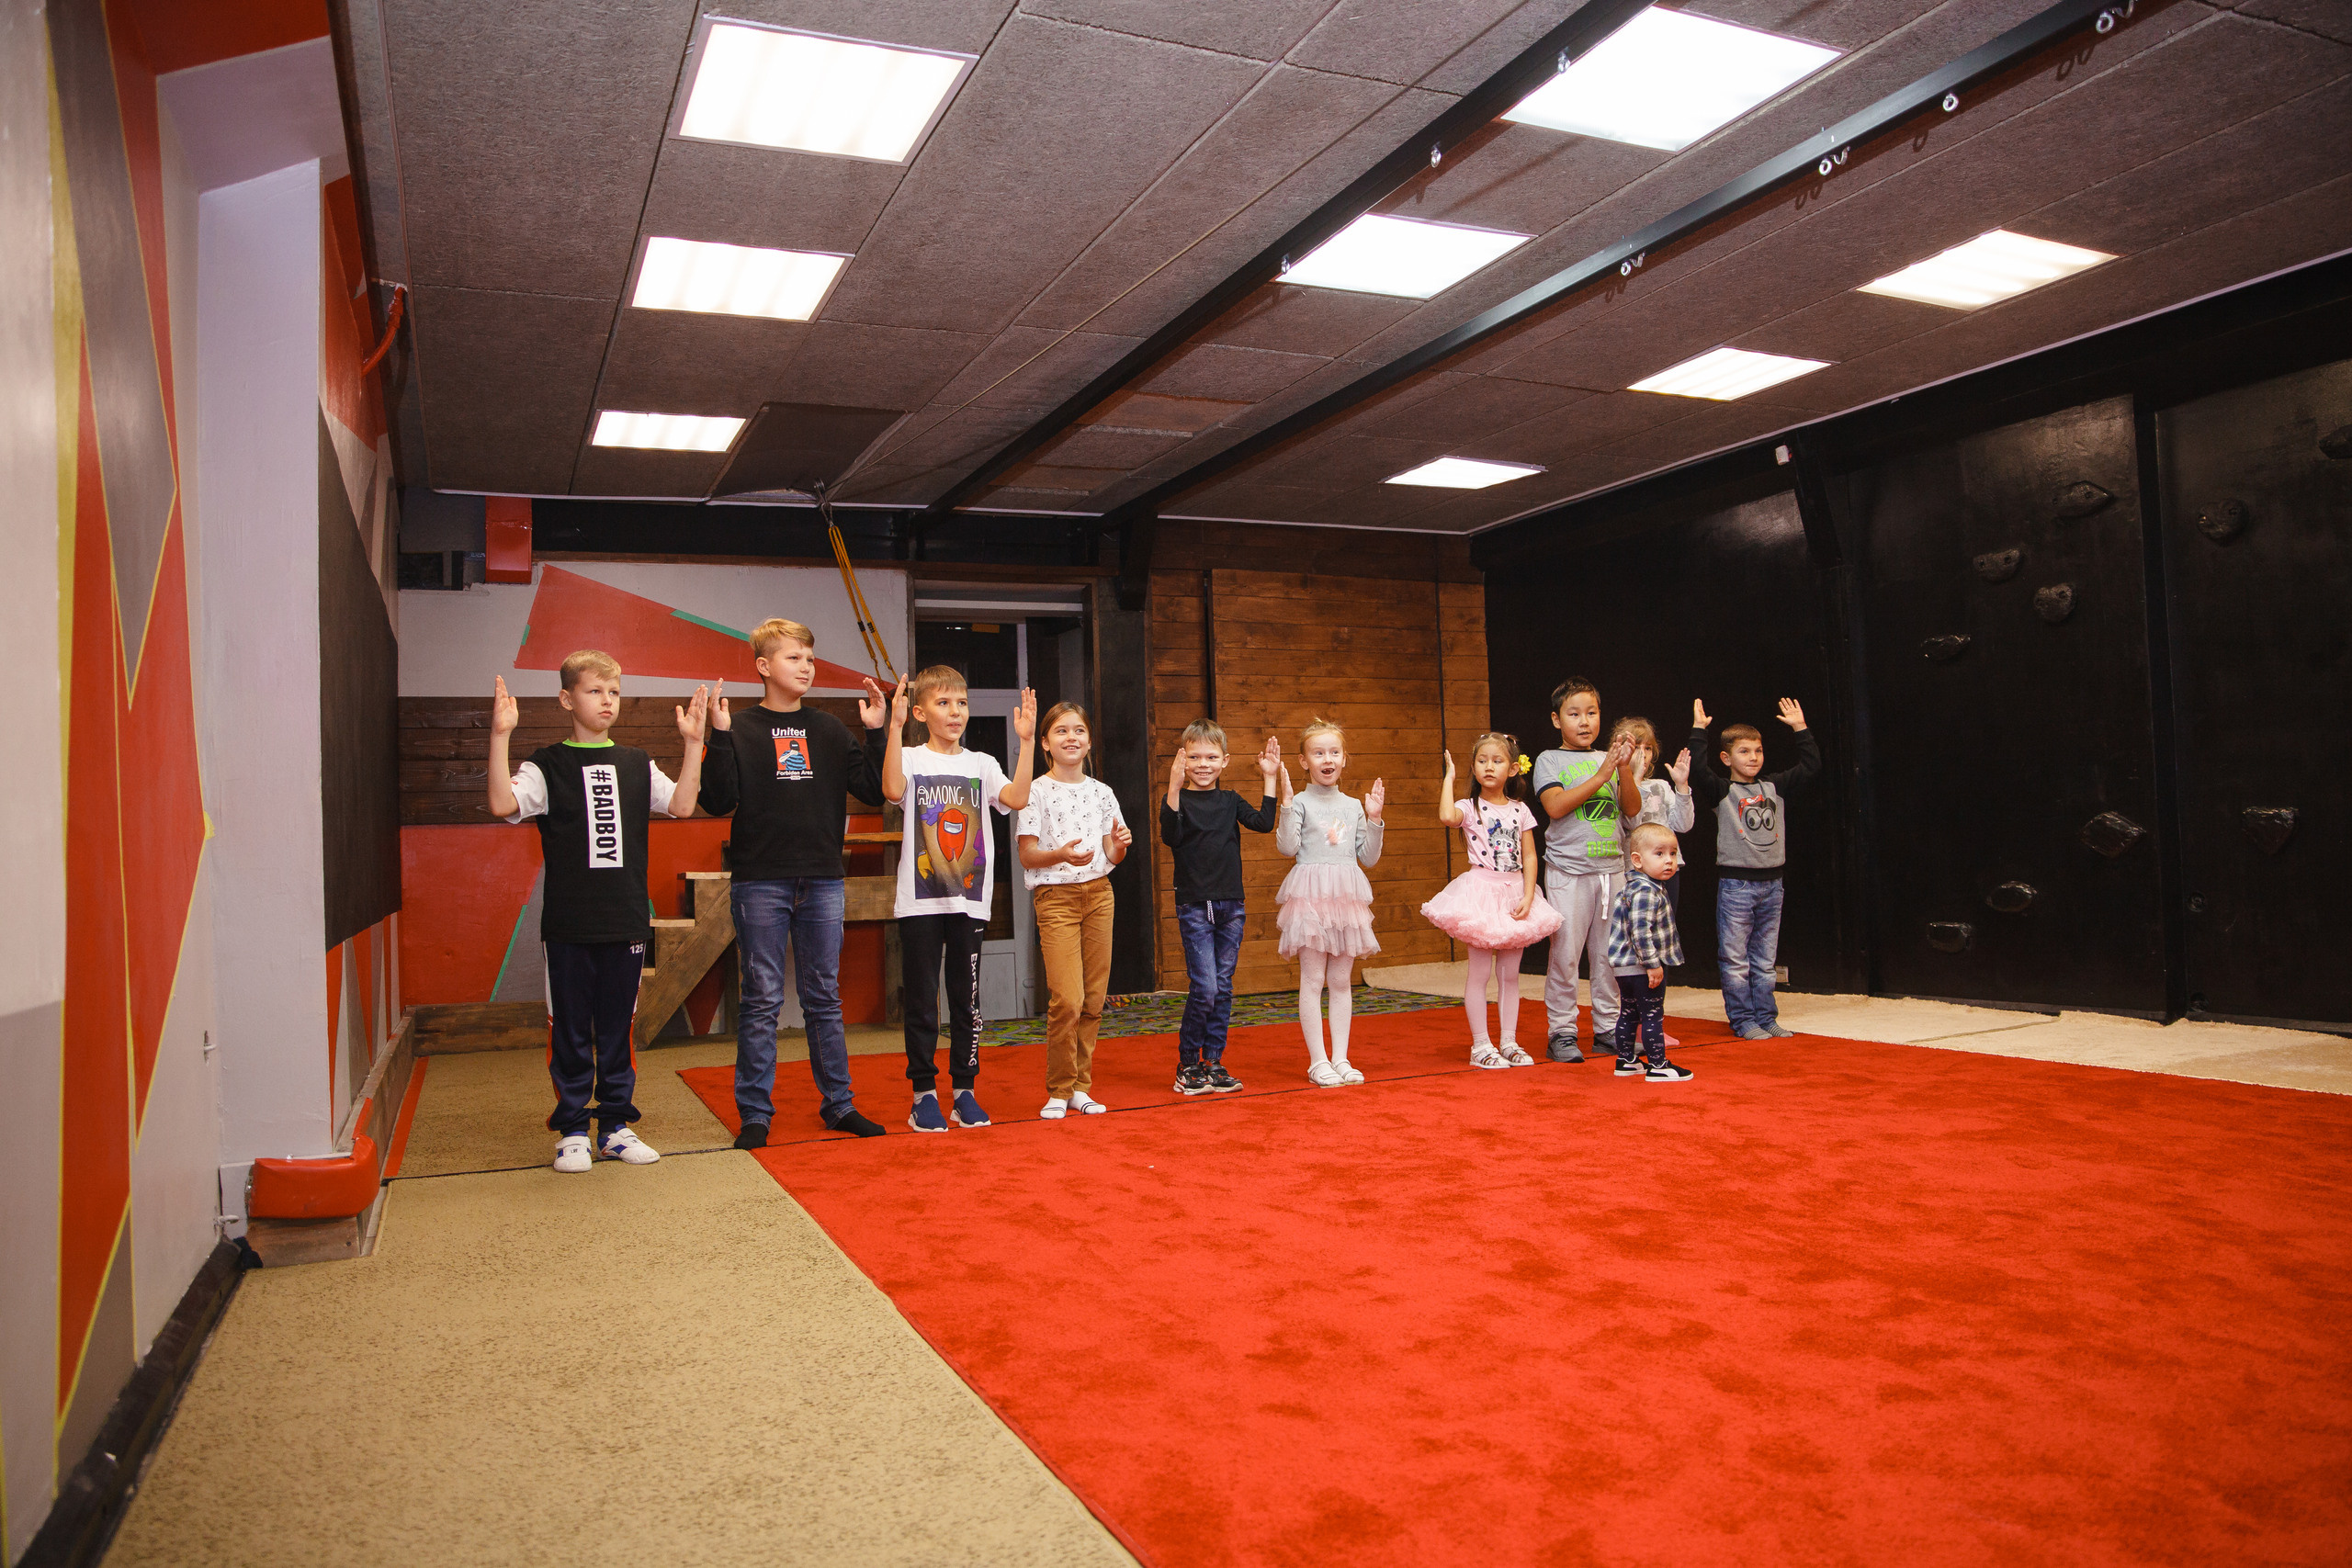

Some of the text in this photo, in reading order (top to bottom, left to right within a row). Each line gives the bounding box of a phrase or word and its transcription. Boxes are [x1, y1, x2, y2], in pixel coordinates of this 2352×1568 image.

[772, 728, 806, 737] United
[1558, 761, 1597, 786] GAME
[917, 785, 979, 808] AMONG U
[590, 770, 617, 862] #BADBOY
[629, 943, 644, 954] 125
